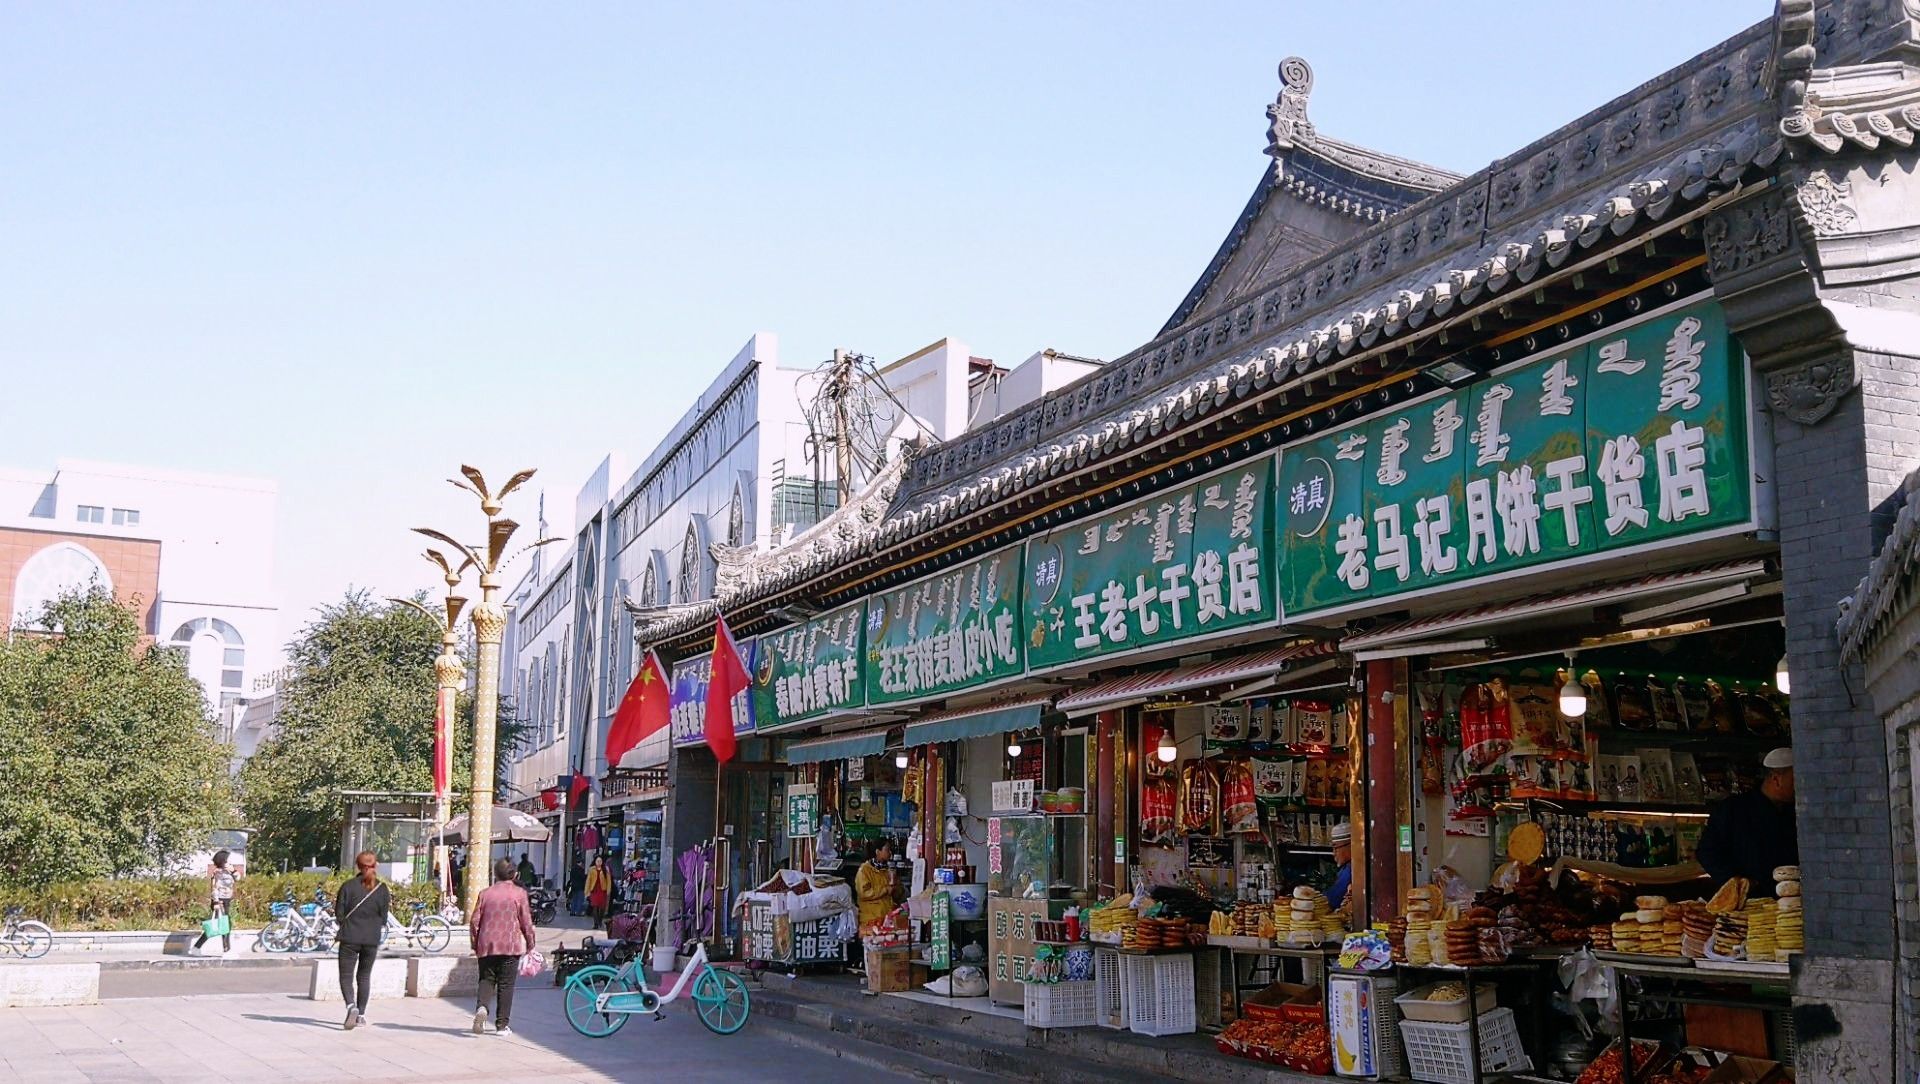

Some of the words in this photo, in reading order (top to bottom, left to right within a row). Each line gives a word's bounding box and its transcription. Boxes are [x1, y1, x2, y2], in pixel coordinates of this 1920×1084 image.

[1290, 475, 1325, 515] 清真
[1335, 419, 1710, 591] 老马记月饼干货店
[1036, 557, 1057, 587] 清真
[1072, 542, 1262, 649] 王老七干货店
[795, 936, 839, 959] 油栗
[932, 898, 940, 963] 老王家
[1012, 910, 1025, 983] 凉面
